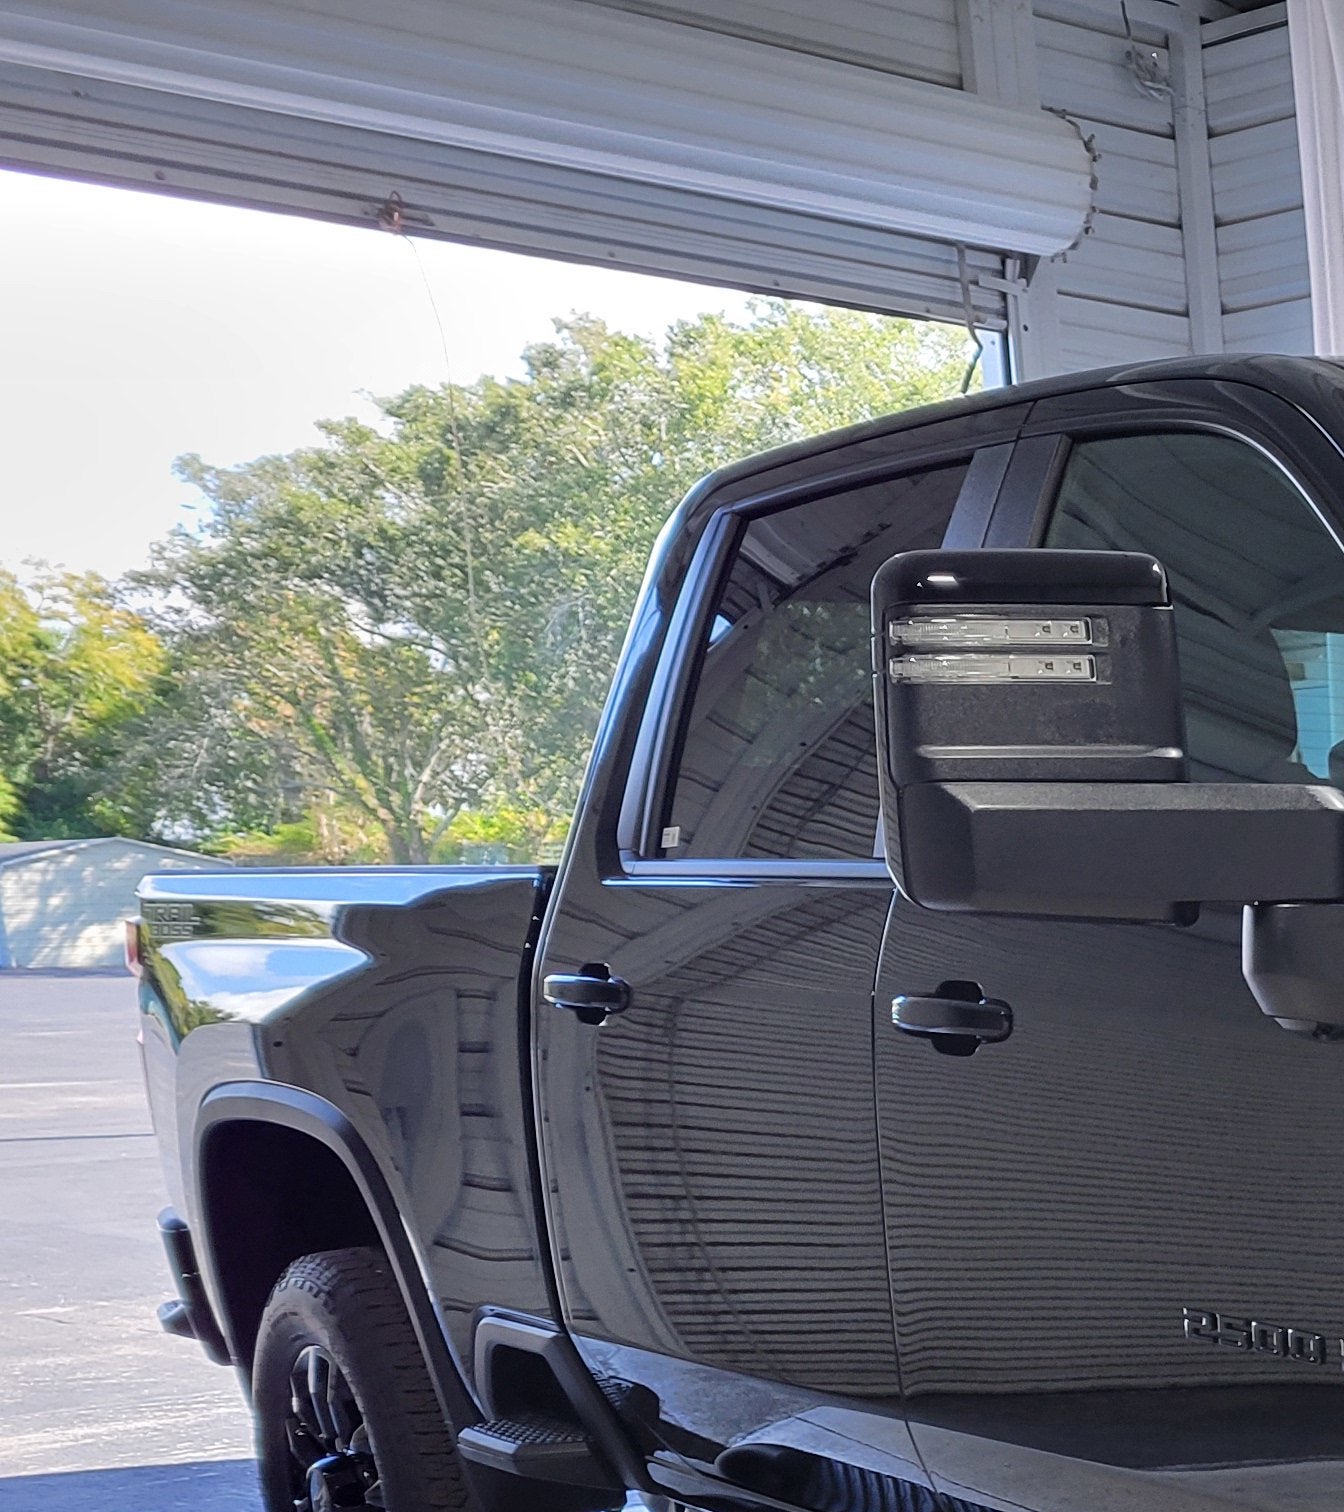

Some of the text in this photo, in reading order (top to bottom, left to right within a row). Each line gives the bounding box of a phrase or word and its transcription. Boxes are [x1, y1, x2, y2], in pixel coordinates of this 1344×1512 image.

[142, 902, 201, 922] TRAIL
[148, 922, 194, 939] BOSS
[1182, 1306, 1327, 1365] 2500
